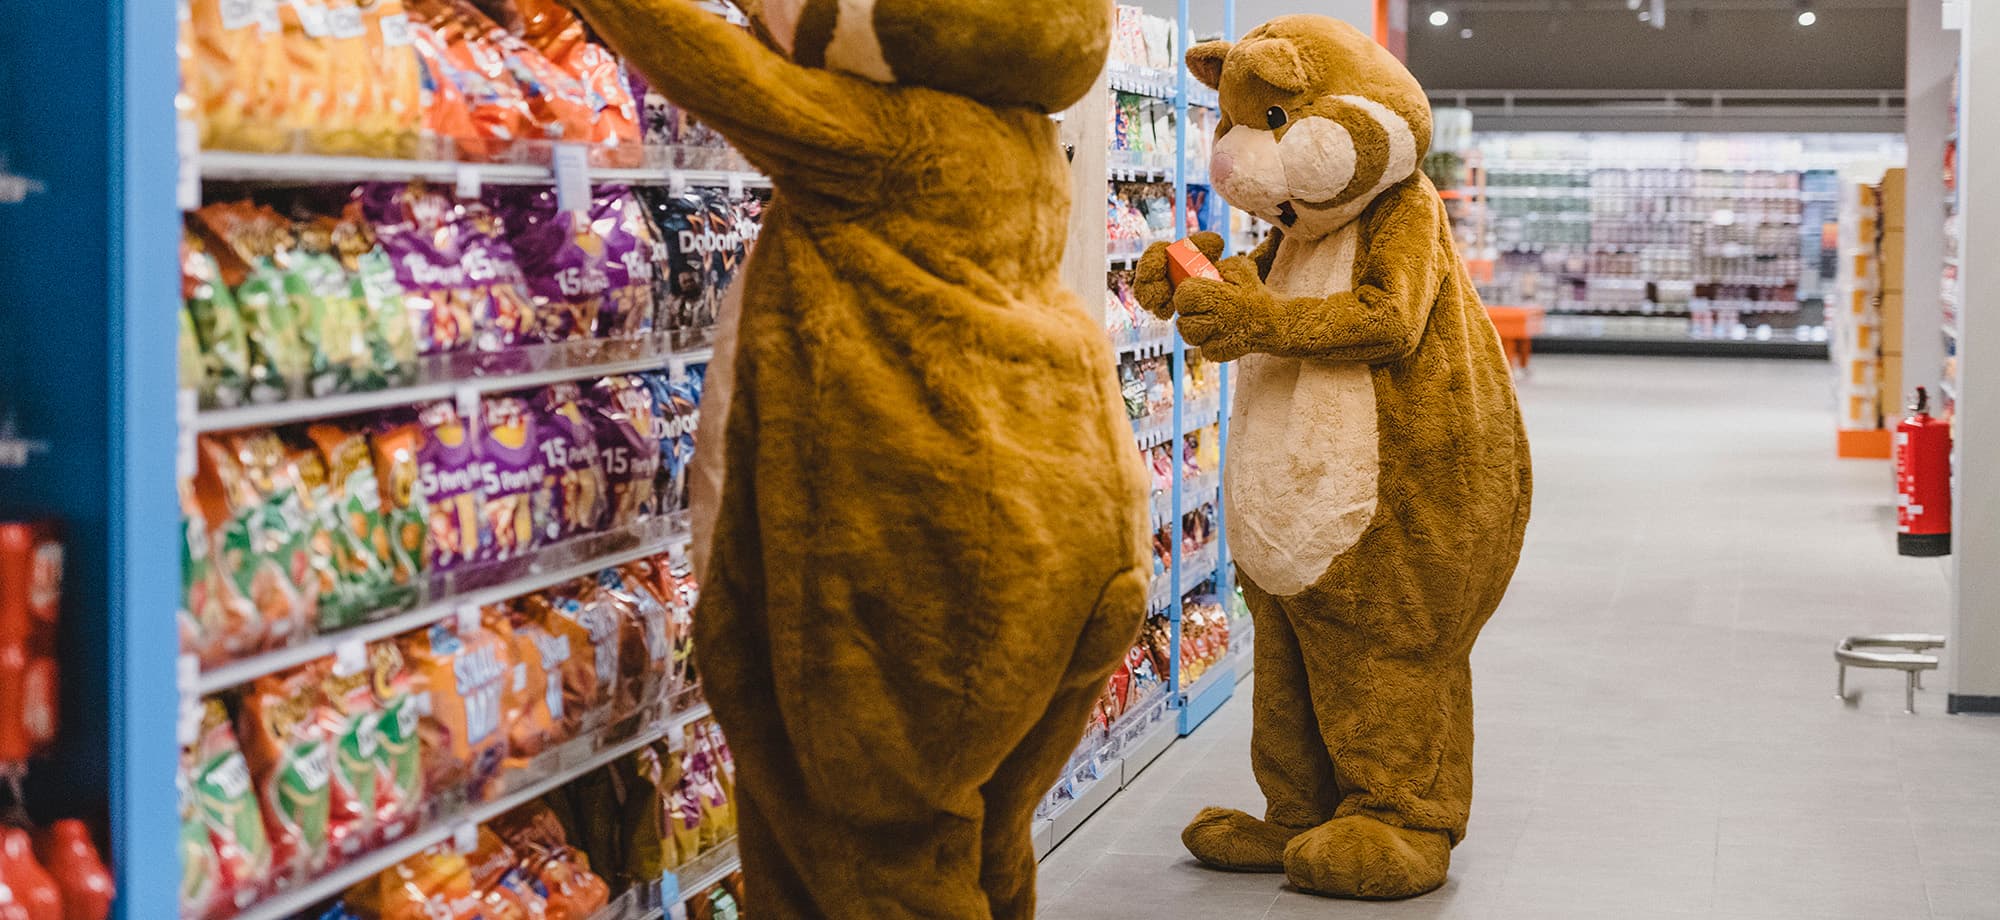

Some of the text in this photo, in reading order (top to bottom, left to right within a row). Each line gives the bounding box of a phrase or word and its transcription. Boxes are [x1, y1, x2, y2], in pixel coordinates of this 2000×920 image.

[554, 267, 582, 296] 15
[539, 436, 568, 469] 15
[601, 447, 629, 475] 15
[420, 461, 439, 496] 5
[480, 461, 500, 496] 5
